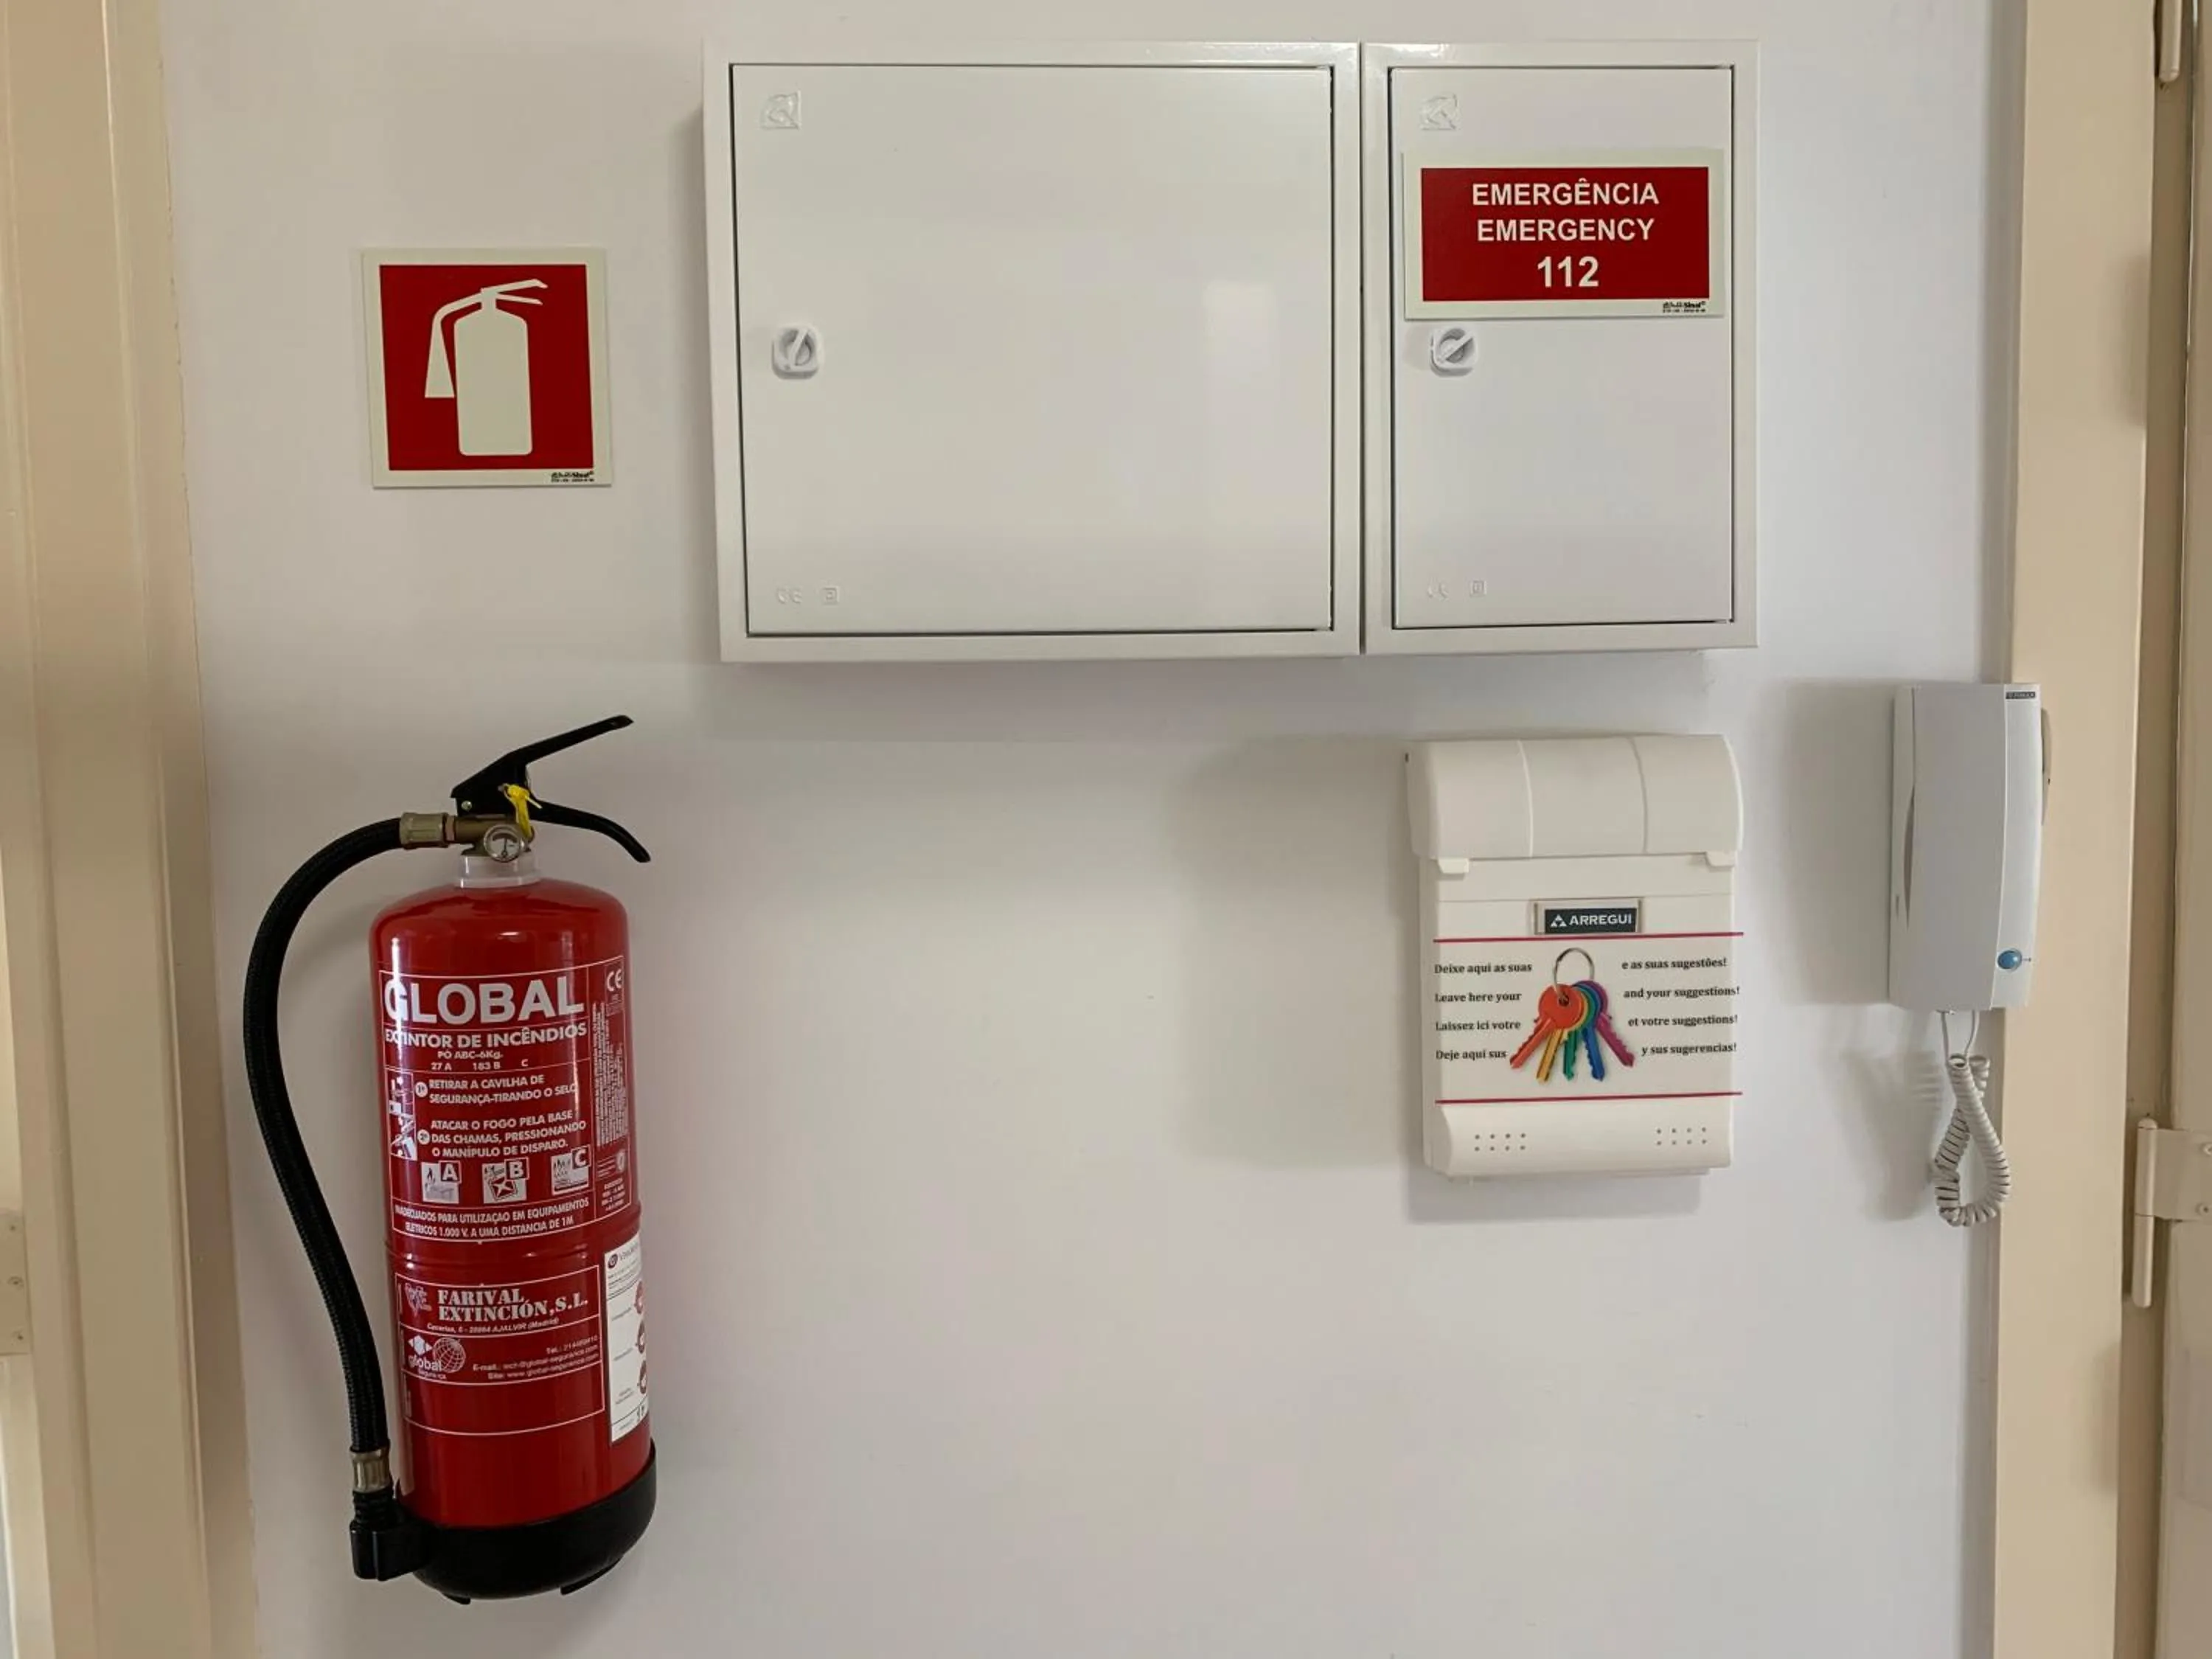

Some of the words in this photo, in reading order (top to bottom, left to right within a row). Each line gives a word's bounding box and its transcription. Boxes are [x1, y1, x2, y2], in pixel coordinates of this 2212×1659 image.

[1472, 178, 1660, 206] EMERGÊNCIA
[1477, 218, 1655, 242] EMERGENCY
[1537, 256, 1600, 288] 112
[1569, 914, 1632, 925] ARREGUI
[1434, 964, 1465, 974] Deixe
[1467, 963, 1491, 975] aqui
[1494, 964, 1506, 973] as
[1508, 964, 1532, 973] suas
[1622, 961, 1629, 970] e
[1631, 961, 1642, 970] as
[1645, 961, 1669, 970] suas
[384, 976, 584, 1025] GLOBAL
[1435, 993, 1466, 1003] Leave
[1469, 992, 1494, 1002] here
[1496, 993, 1522, 1003] your
[1624, 988, 1644, 998] and
[1646, 990, 1672, 1000] your
[1674, 986, 1739, 998] suggestions!
[1436, 1020, 1475, 1032] Laissez
[1477, 1020, 1489, 1030] ici
[1492, 1020, 1521, 1030] votre
[1628, 1018, 1638, 1026] et
[1641, 1017, 1670, 1026] votre
[1672, 1015, 1738, 1027] suggestions!
[458, 1034, 481, 1048] DE
[487, 1023, 587, 1048] INCÊNDIOS
[1436, 1049, 1460, 1060] Deje
[1489, 1050, 1507, 1058] sus
[1641, 1046, 1649, 1057] y
[1651, 1046, 1669, 1054] sus
[1670, 1043, 1737, 1055] sugerencias!
[431, 1062, 443, 1071] 27
[445, 1062, 453, 1071] A
[493, 1061, 501, 1070] B
[521, 1059, 529, 1067] C
[428, 1079, 469, 1089] RETIRAR
[470, 1079, 479, 1089] A
[481, 1077, 528, 1088] CAVILHA
[530, 1074, 545, 1085] DE
[543, 1088, 553, 1097] O
[431, 1120, 469, 1130] ATACAR
[471, 1121, 481, 1130] O
[483, 1118, 517, 1130] FOGO
[519, 1115, 546, 1127] PELA
[548, 1110, 573, 1123] BASE
[431, 1134, 452, 1144] DAS
[453, 1134, 502, 1145] CHAMAS,
[504, 1120, 587, 1142] PRESSIONANDO
[431, 1147, 440, 1156] O
[503, 1145, 518, 1156] DE
[520, 1138, 568, 1154] DISPARO.
[574, 1150, 587, 1166] C
[442, 1163, 459, 1181] A
[509, 1158, 524, 1176] B
[512, 1210, 526, 1220] EM
[527, 1197, 589, 1219] EQUIPAMENTOS
[470, 1227, 478, 1237] A
[479, 1226, 500, 1237] UMA
[549, 1218, 560, 1229] DE
[438, 1288, 524, 1306] FARIVAL
